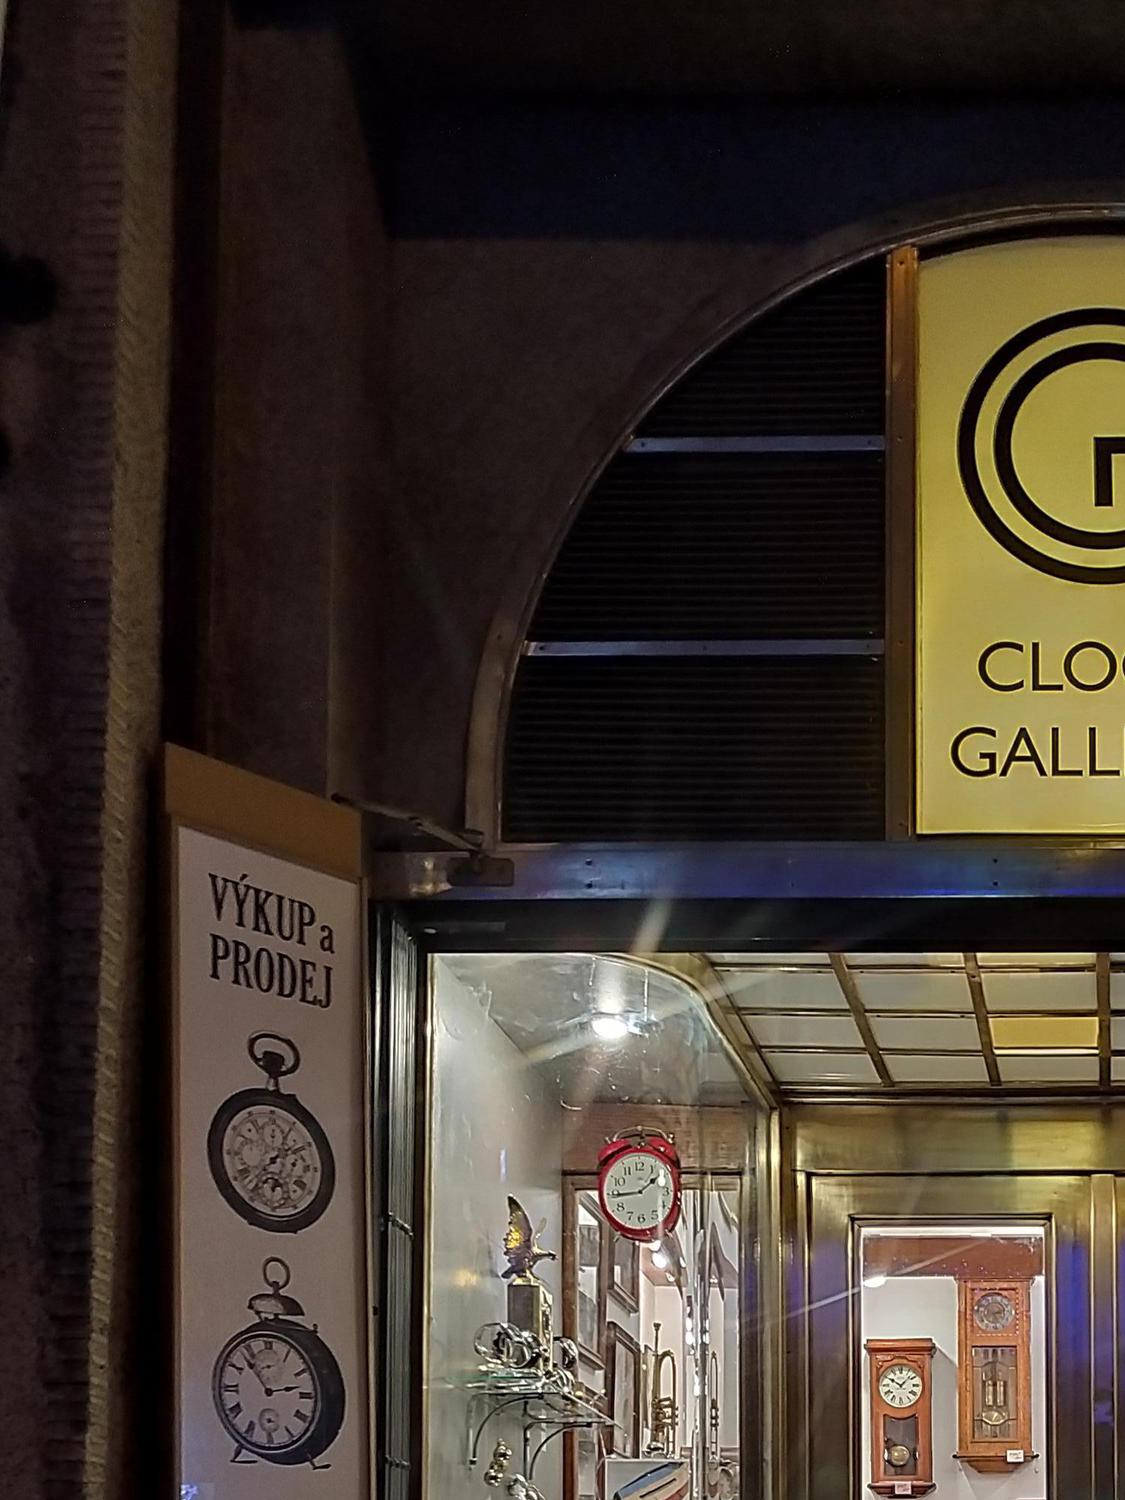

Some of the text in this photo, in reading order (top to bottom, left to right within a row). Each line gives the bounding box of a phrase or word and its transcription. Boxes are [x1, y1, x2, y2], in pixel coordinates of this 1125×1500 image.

[208, 872, 335, 954] VÝKUP a
[209, 932, 334, 1009] PRODEJ
[635, 1162, 645, 1171] 12
[624, 1167, 631, 1176] 11
[614, 1178, 625, 1187] 10
[662, 1187, 669, 1197] 3
[616, 1202, 625, 1212] 8
[627, 1212, 633, 1221] 7
[637, 1214, 646, 1224] 6
[651, 1211, 659, 1220] 5
